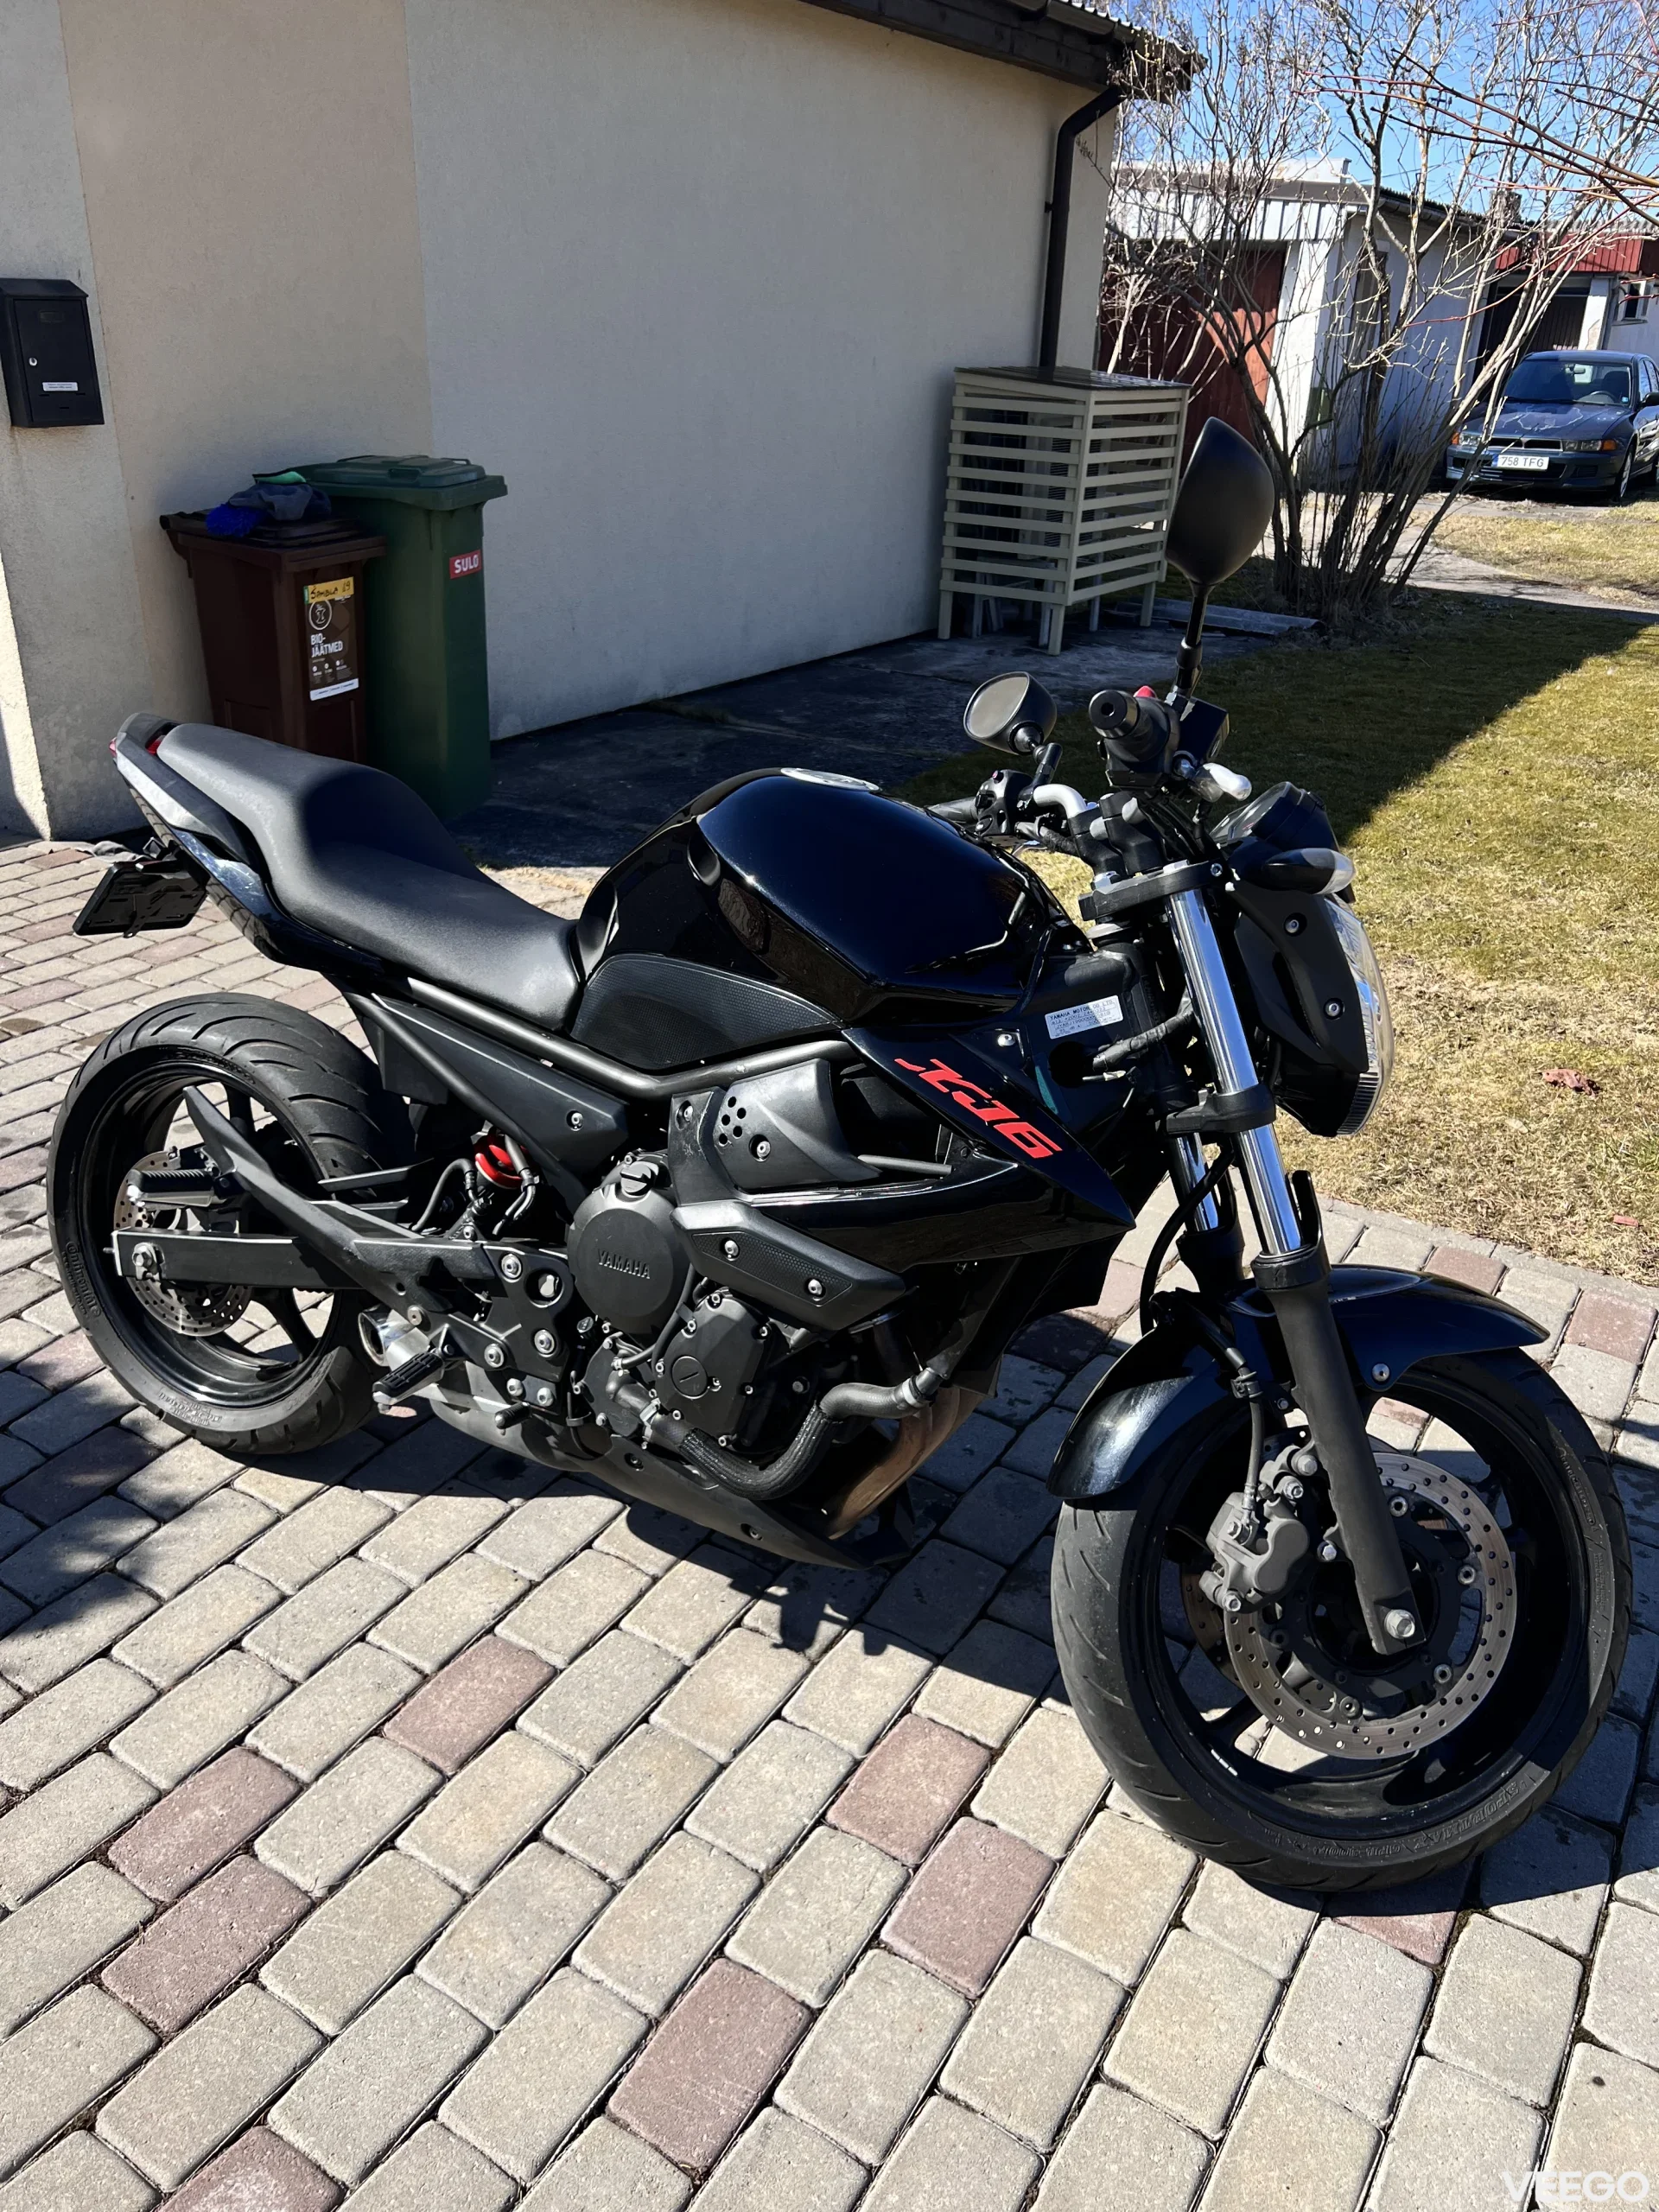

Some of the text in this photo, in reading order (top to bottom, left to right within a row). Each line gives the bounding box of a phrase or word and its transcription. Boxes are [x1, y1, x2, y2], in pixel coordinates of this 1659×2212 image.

[1500, 456, 1545, 467] 758 TFG
[454, 554, 480, 575] SULO
[311, 632, 327, 645] BIO-
[311, 640, 344, 658] JÄÄTMED
[1049, 1011, 1071, 1020] YAMAHA
[1073, 1005, 1090, 1014] MOTOR
[893, 1058, 1063, 1159] XJ6
[598, 1249, 652, 1280] YAMAHA
